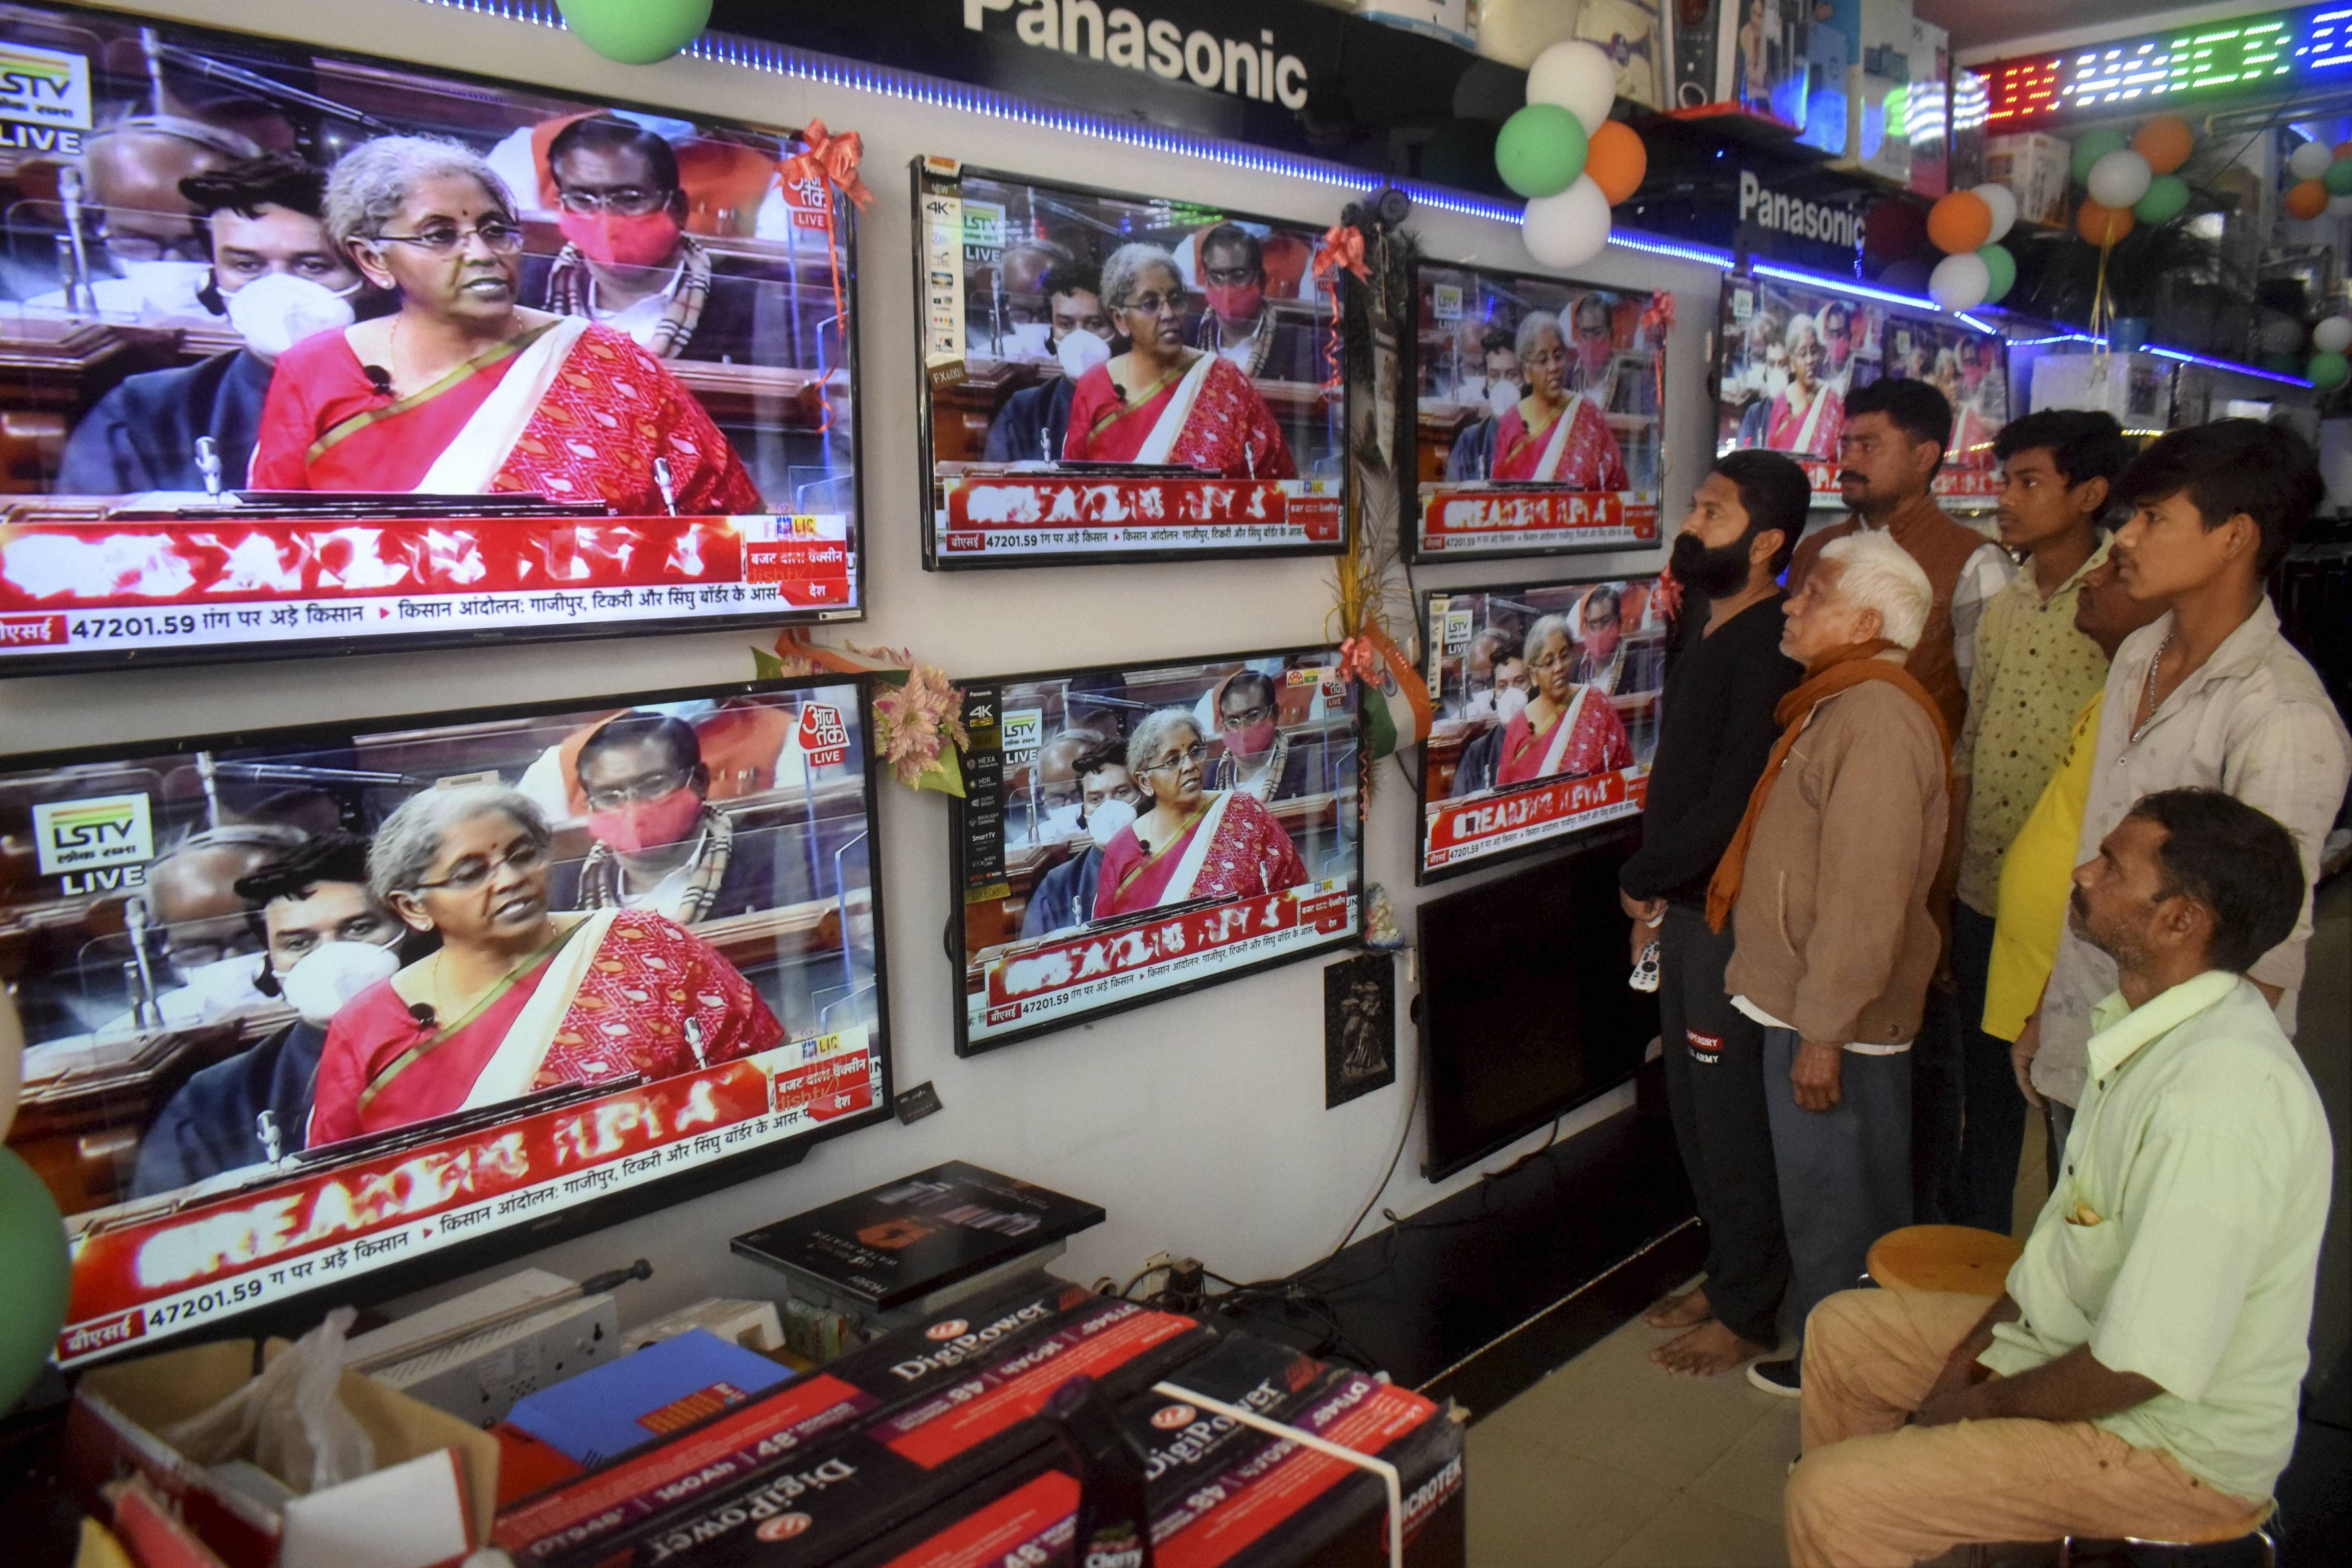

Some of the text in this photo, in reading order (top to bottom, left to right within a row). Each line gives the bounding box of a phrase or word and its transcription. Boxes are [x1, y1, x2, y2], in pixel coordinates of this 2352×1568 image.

[926, 201, 949, 216] 4K
[1740, 169, 1866, 250] Panasonic
[798, 212, 825, 227] LIVE
[966, 246, 1003, 262] LIVE
[794, 518, 814, 533] LIC
[986, 535, 1038, 548] 47201.59
[1082, 530, 1108, 543] किसान
[1123, 528, 1148, 541] किसान
[398, 599, 453, 619] किसान
[459, 595, 525, 616] आंदोलन:
[592, 590, 633, 609] टिकरी
[638, 588, 663, 607] और
[732, 585, 745, 602] के
[72, 614, 196, 638] 47201.59
[237, 611, 261, 627] पर
[270, 605, 299, 628] अड़े
[306, 603, 364, 624] किसान
[1448, 621, 1469, 633] LSTV
[1448, 643, 1468, 655] LIVE
[969, 689, 992, 698] Panasonic
[1328, 697, 1342, 707] LIVE
[969, 704, 993, 718] 4K
[970, 718, 993, 727] HDR
[1004, 722, 1036, 738] LSTV
[814, 750, 840, 765] LIVE
[978, 756, 996, 764] HEXA
[1005, 749, 1038, 765] LIVE
[978, 812, 999, 820] BACKLIGHT
[54, 819, 133, 849] LSTV
[972, 833, 988, 842] Smart
[1449, 844, 1479, 859] 47201.59
[61, 864, 146, 896] LIVE
[1147, 964, 1171, 979] किसान
[1229, 940, 1248, 956] टिकरी
[1249, 937, 1261, 951] और
[1022, 994, 1069, 1014] 47201.59
[1110, 973, 1134, 989] किसान
[819, 1036, 839, 1054] LIC
[1696, 1052, 1718, 1063] ARMY
[834, 1094, 852, 1110] देश
[440, 1206, 491, 1235] किसान
[497, 1188, 559, 1216] आंदोलन:
[622, 1150, 662, 1177] टिकरी
[667, 1143, 690, 1163] और
[755, 1119, 768, 1135] के
[149, 1279, 264, 1326] 47201.59
[290, 1260, 315, 1278] पर
[320, 1248, 349, 1271] अड़े
[354, 1230, 410, 1262] किसान
[888, 1299, 1047, 1381] DigiPower
[1402, 1453, 1462, 1522] ICROTEK
[650, 1458, 858, 1561] DigiPower
